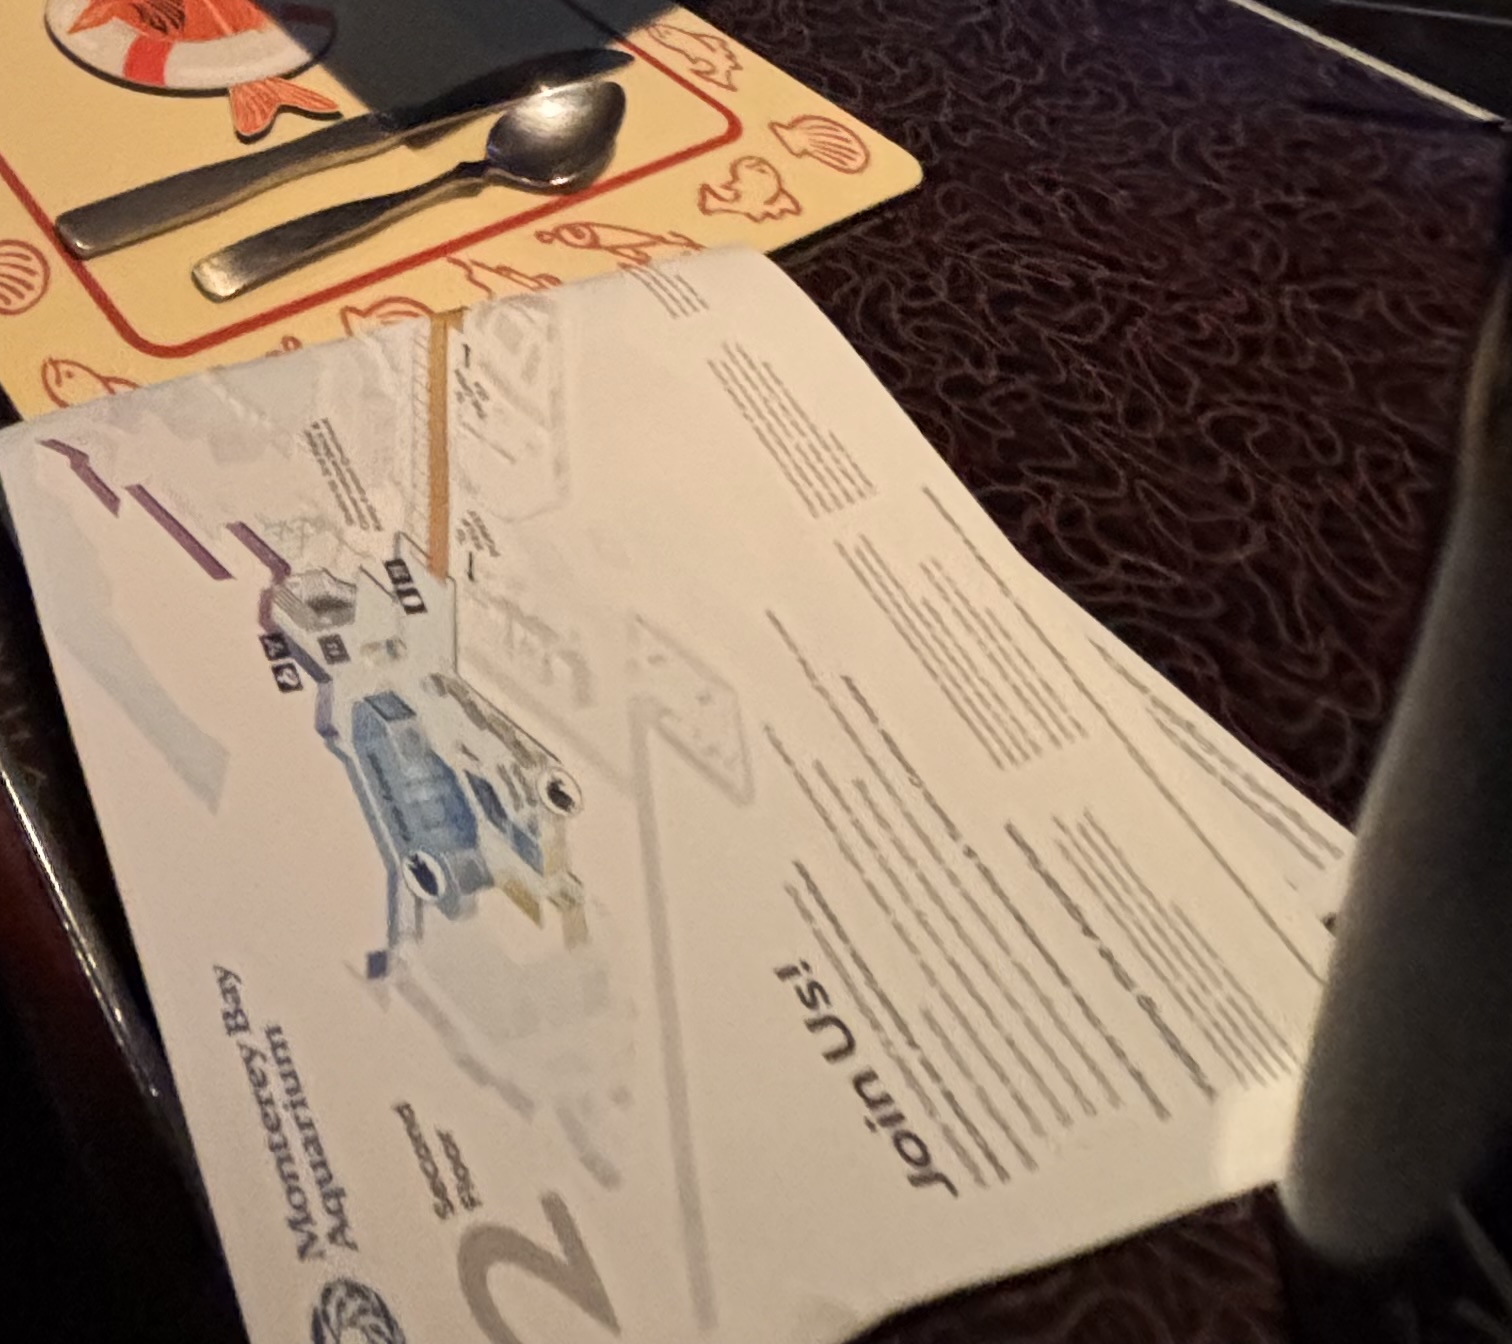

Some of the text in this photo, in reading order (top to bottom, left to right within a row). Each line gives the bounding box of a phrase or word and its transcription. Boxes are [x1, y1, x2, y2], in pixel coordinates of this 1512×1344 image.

[774, 957, 857, 1065] Us!
[213, 963, 325, 1262] Monterey Bay
[264, 1021, 360, 1254] Aquarium
[392, 1100, 454, 1221] Second
[436, 1126, 483, 1213] Floor
[852, 1071, 958, 1199] Join
[457, 1190, 622, 1344] 2
